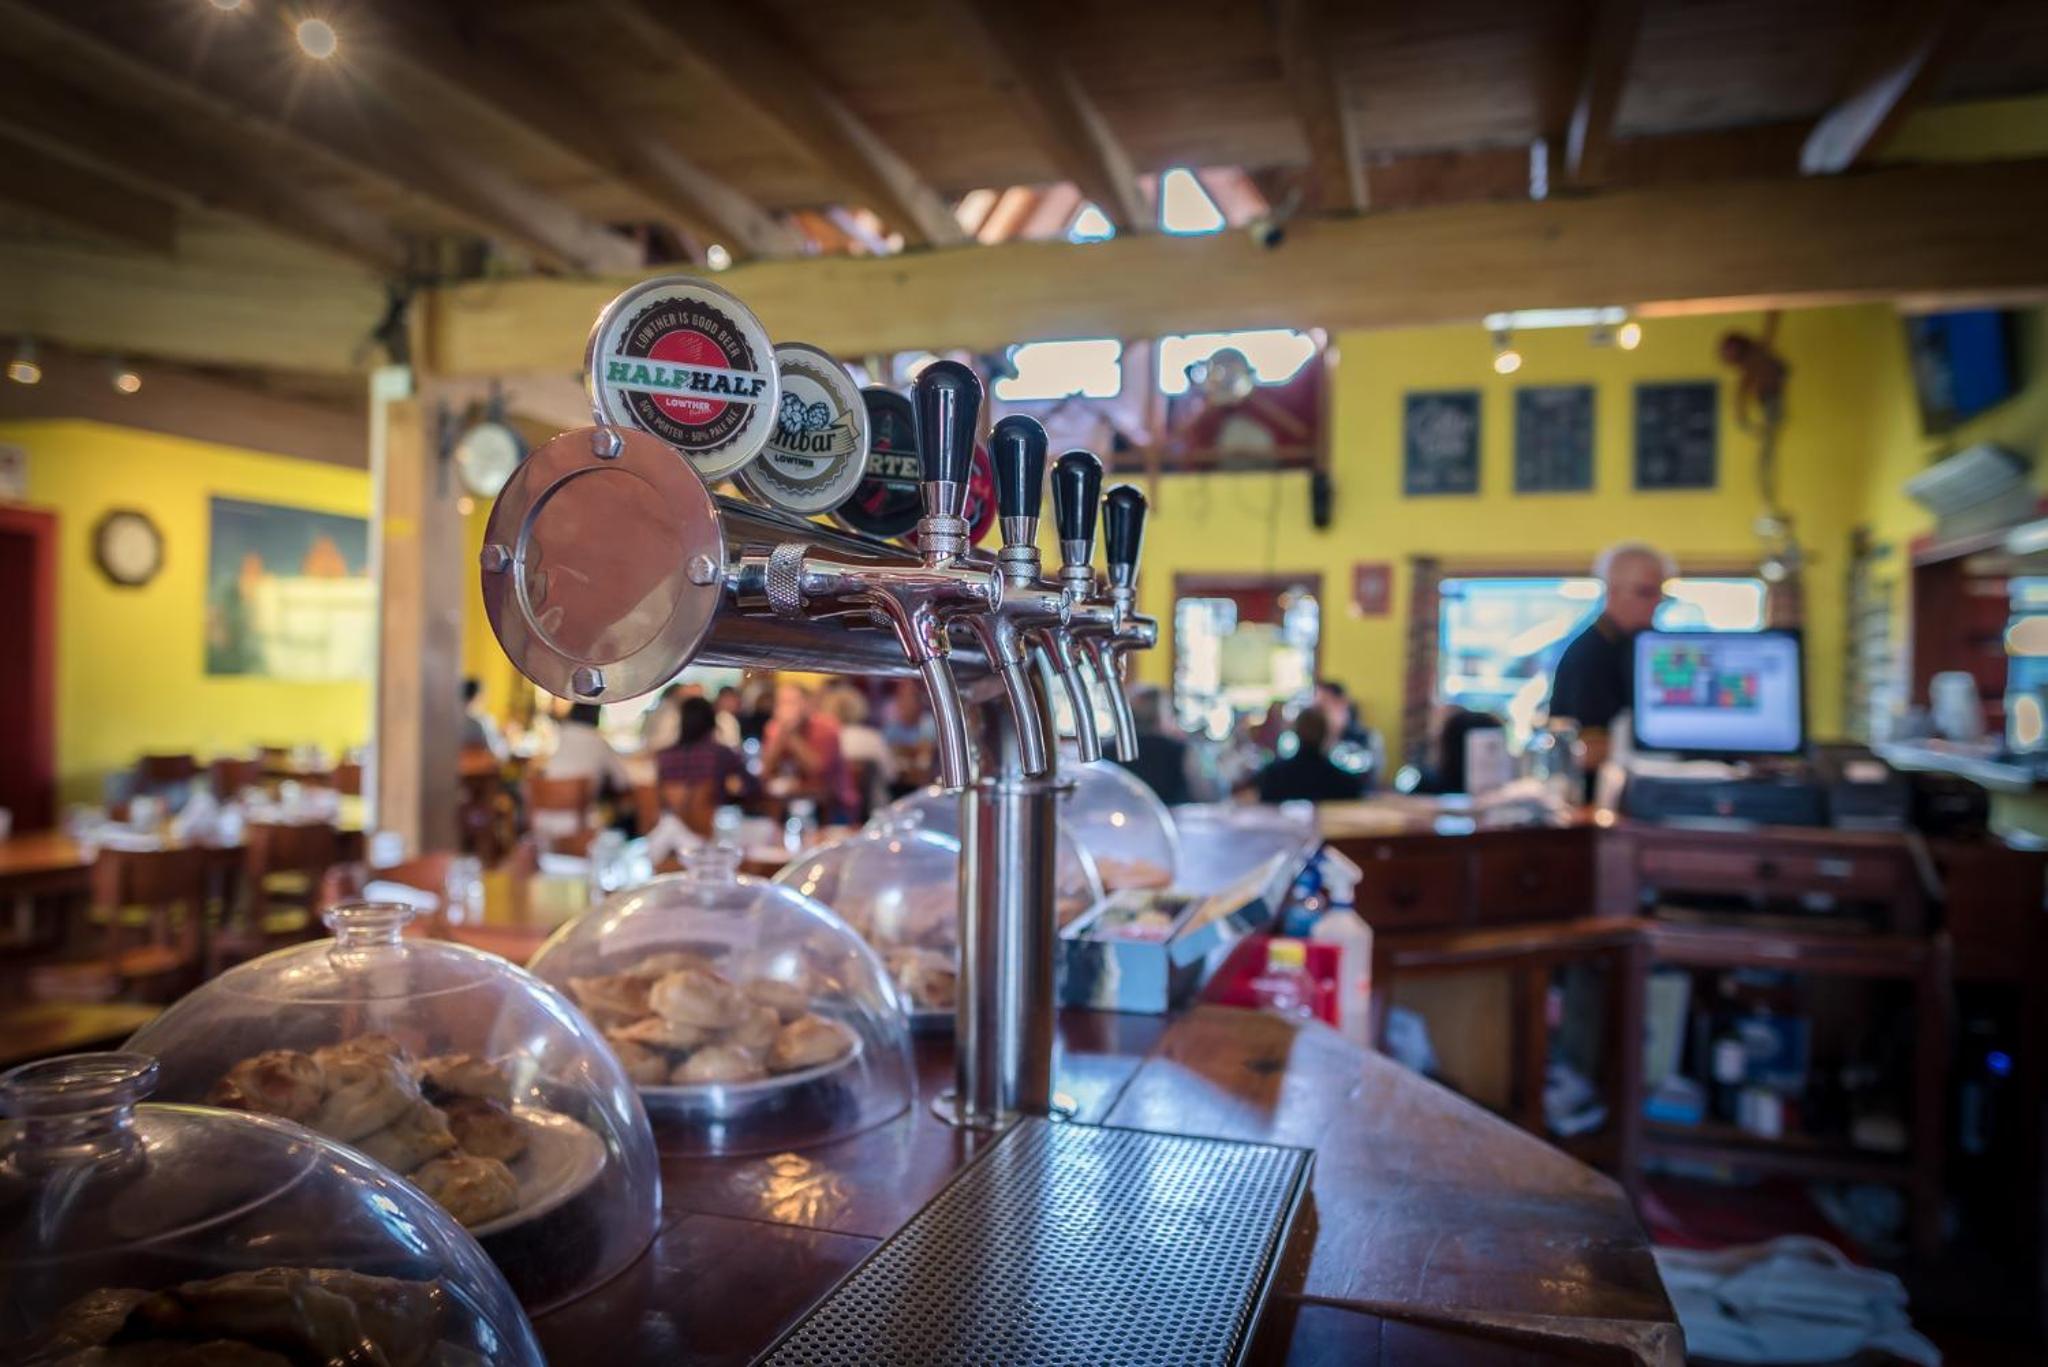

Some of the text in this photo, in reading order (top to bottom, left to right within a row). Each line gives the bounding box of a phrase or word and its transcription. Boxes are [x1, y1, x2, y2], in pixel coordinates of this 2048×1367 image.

[635, 311, 740, 357] LOWTHER IS GOOD BEER
[665, 398, 711, 411] LOWTHER
[709, 423, 728, 440] PALE
[725, 410, 740, 426] ALE
[774, 454, 815, 468] LOWTHER
